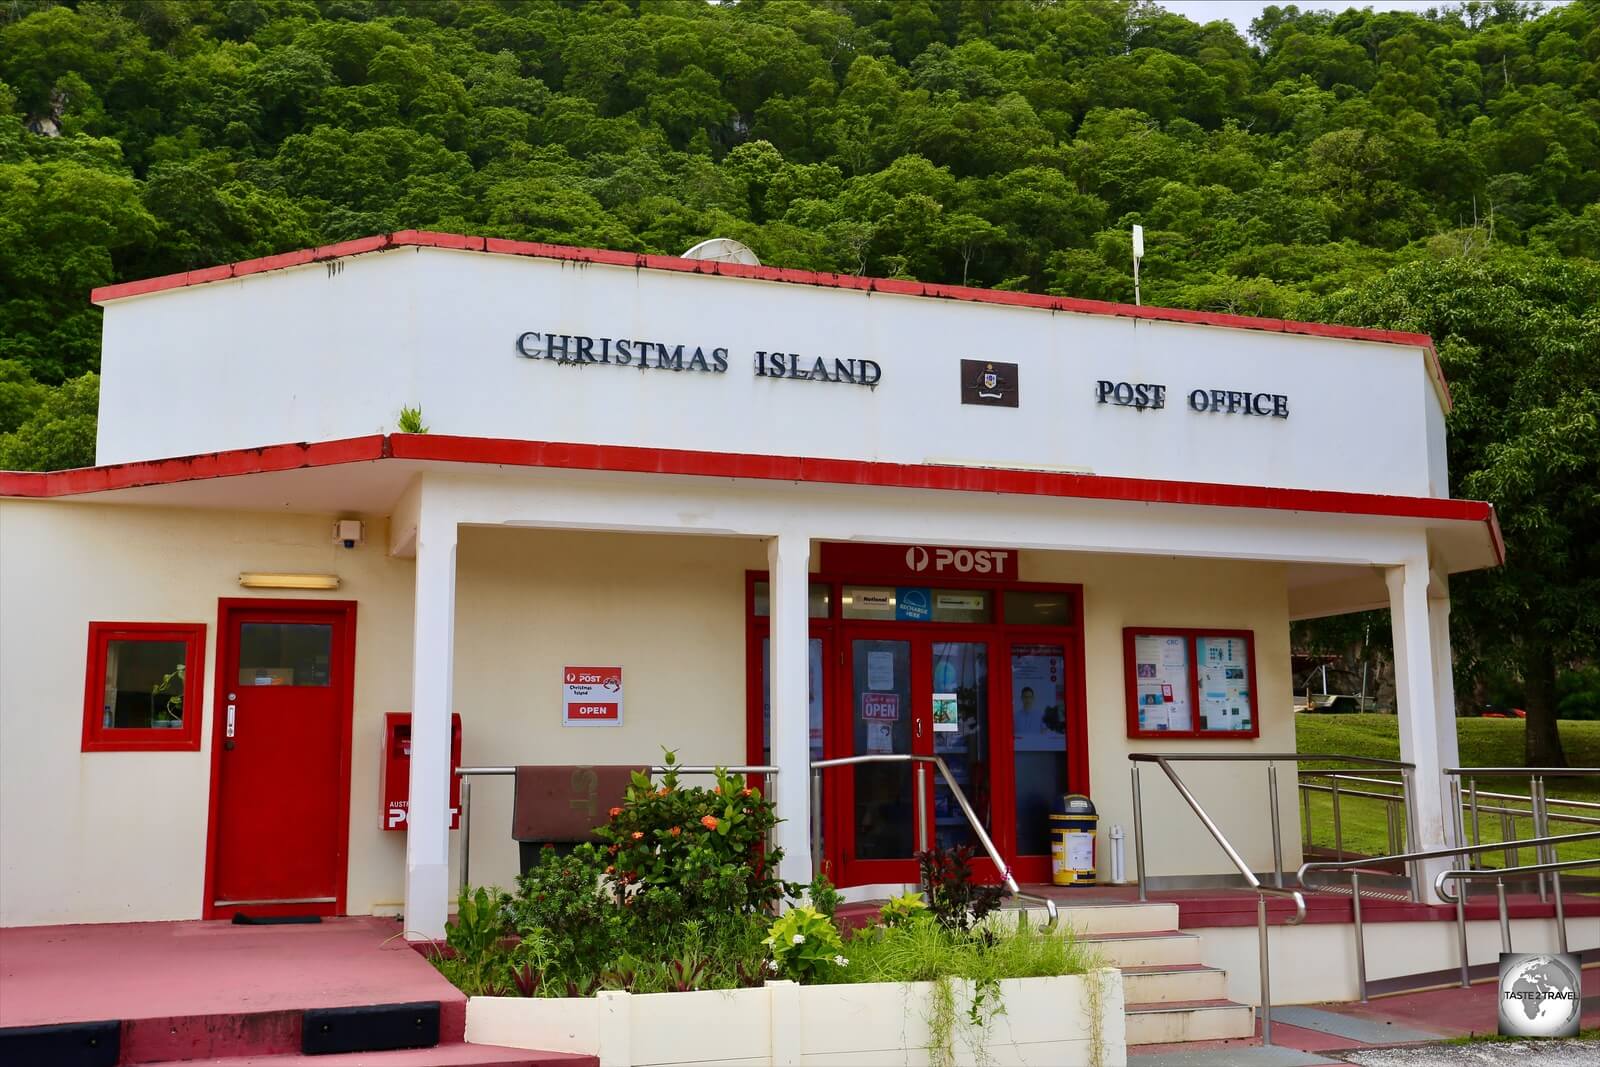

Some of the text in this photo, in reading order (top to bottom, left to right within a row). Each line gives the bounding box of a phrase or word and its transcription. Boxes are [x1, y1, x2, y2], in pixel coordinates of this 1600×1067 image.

[516, 331, 1290, 419] CHRISTMAS ISLAND POST OFFICE
[936, 549, 1008, 574] POST
[579, 675, 601, 683] POST
[579, 706, 607, 715] OPEN
[865, 703, 896, 718] OPEN
